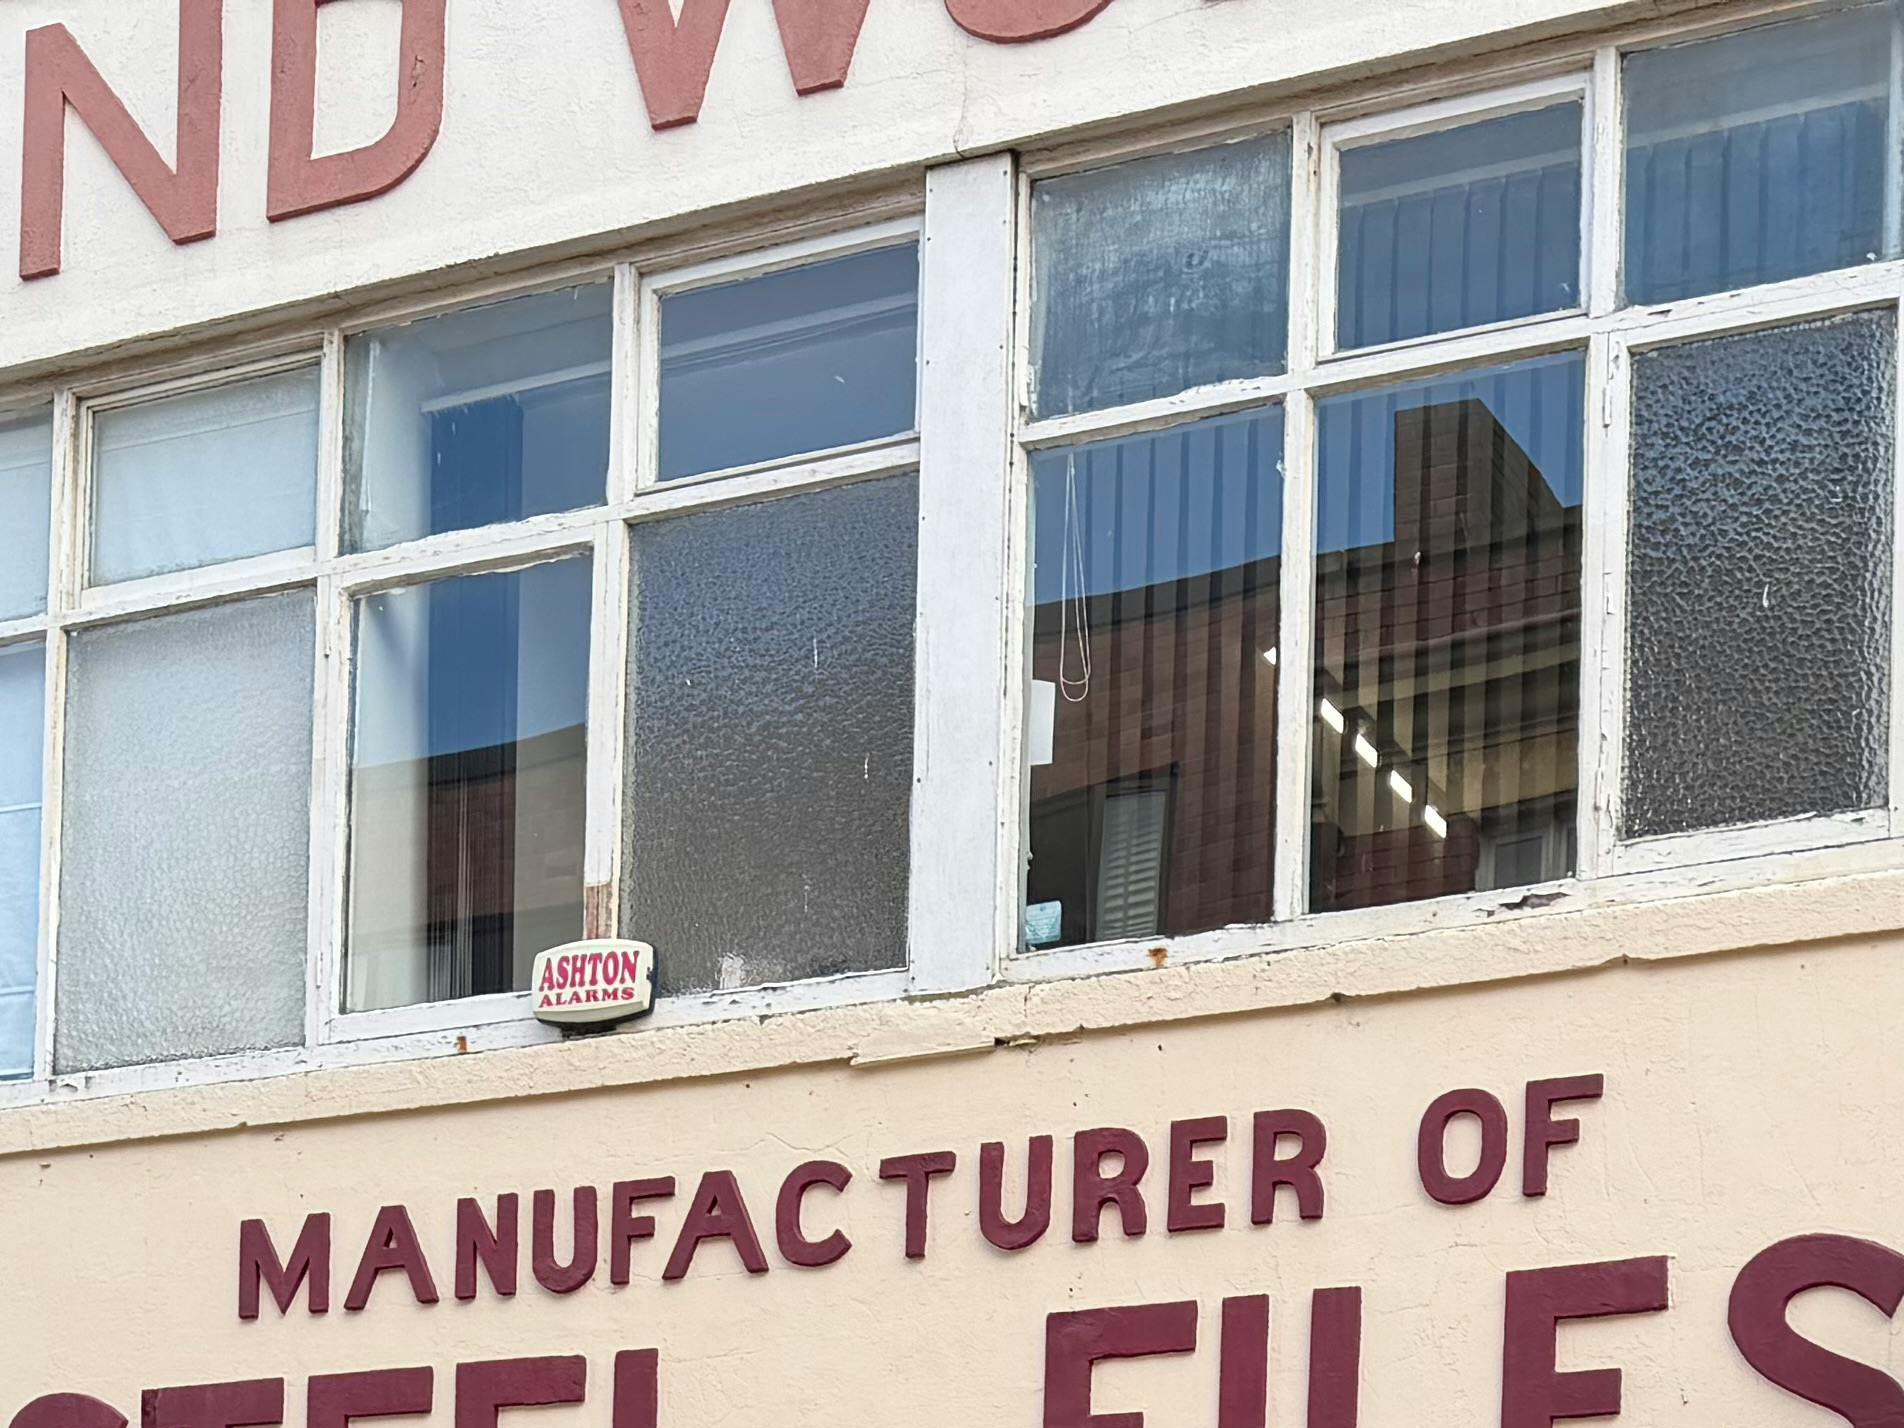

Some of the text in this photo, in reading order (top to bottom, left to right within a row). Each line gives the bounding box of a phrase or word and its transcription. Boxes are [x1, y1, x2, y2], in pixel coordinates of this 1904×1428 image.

[539, 950, 640, 992] ASHTON
[539, 987, 635, 1008] ALARMS
[240, 1077, 1604, 1320] MANUFACTURER OF
